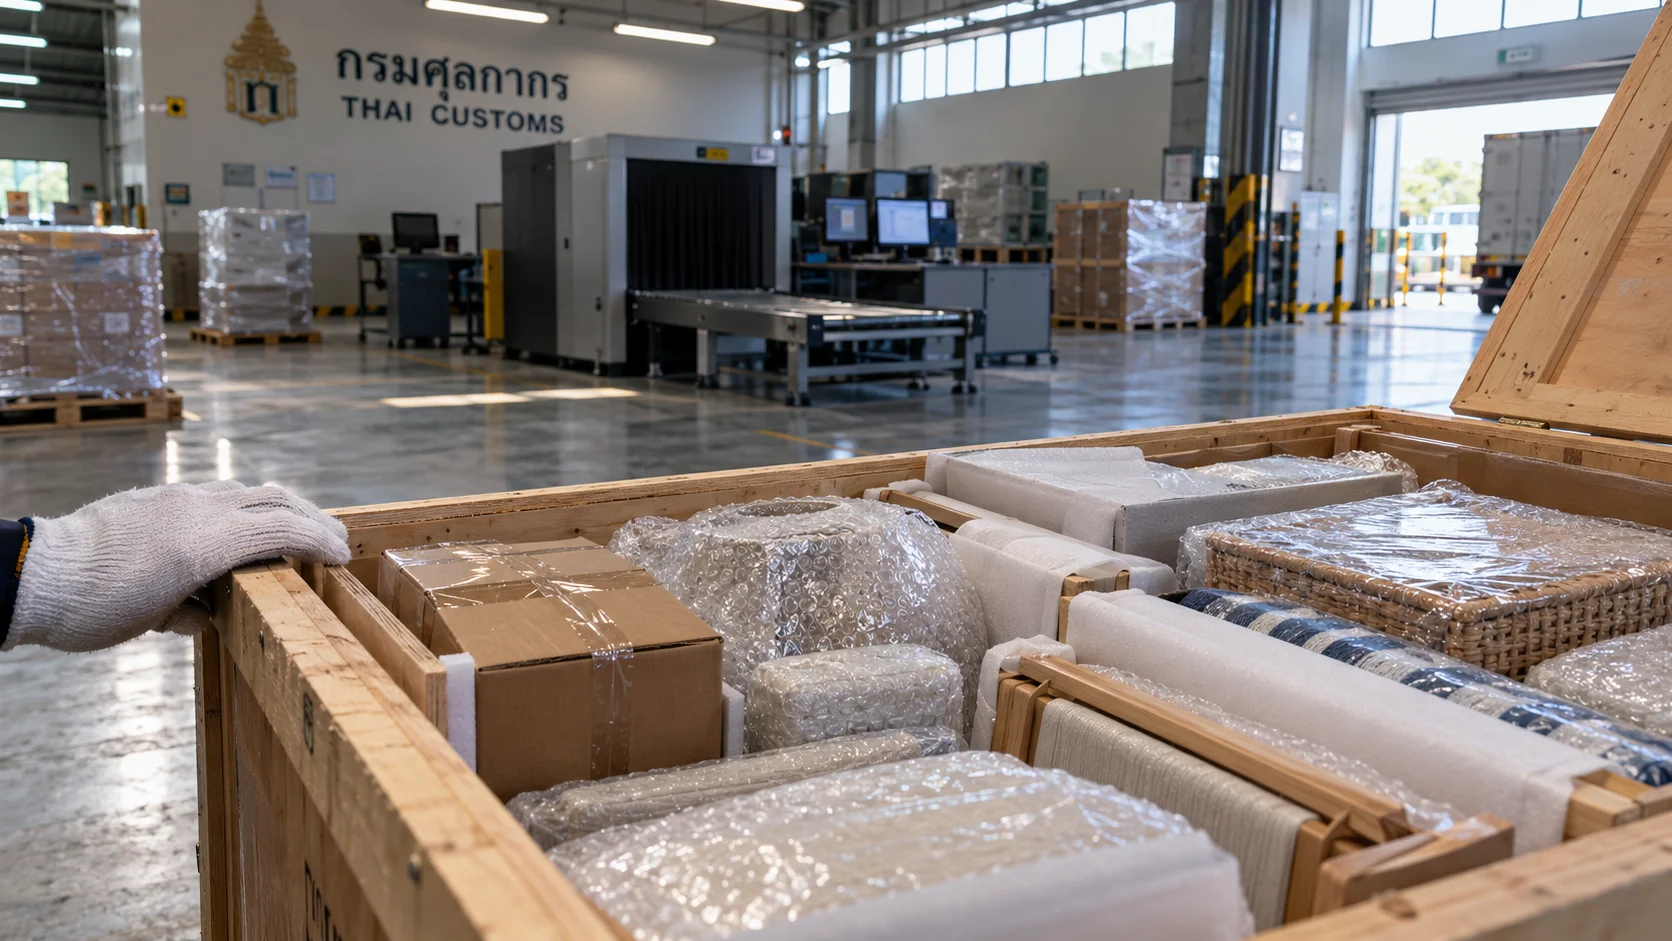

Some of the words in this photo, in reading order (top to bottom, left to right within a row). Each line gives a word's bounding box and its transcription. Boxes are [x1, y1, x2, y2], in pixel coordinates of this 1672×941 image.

[336, 48, 570, 102] กรมศุลกากร
[340, 95, 412, 123] THAI
[430, 104, 565, 134] CUSTOMS
